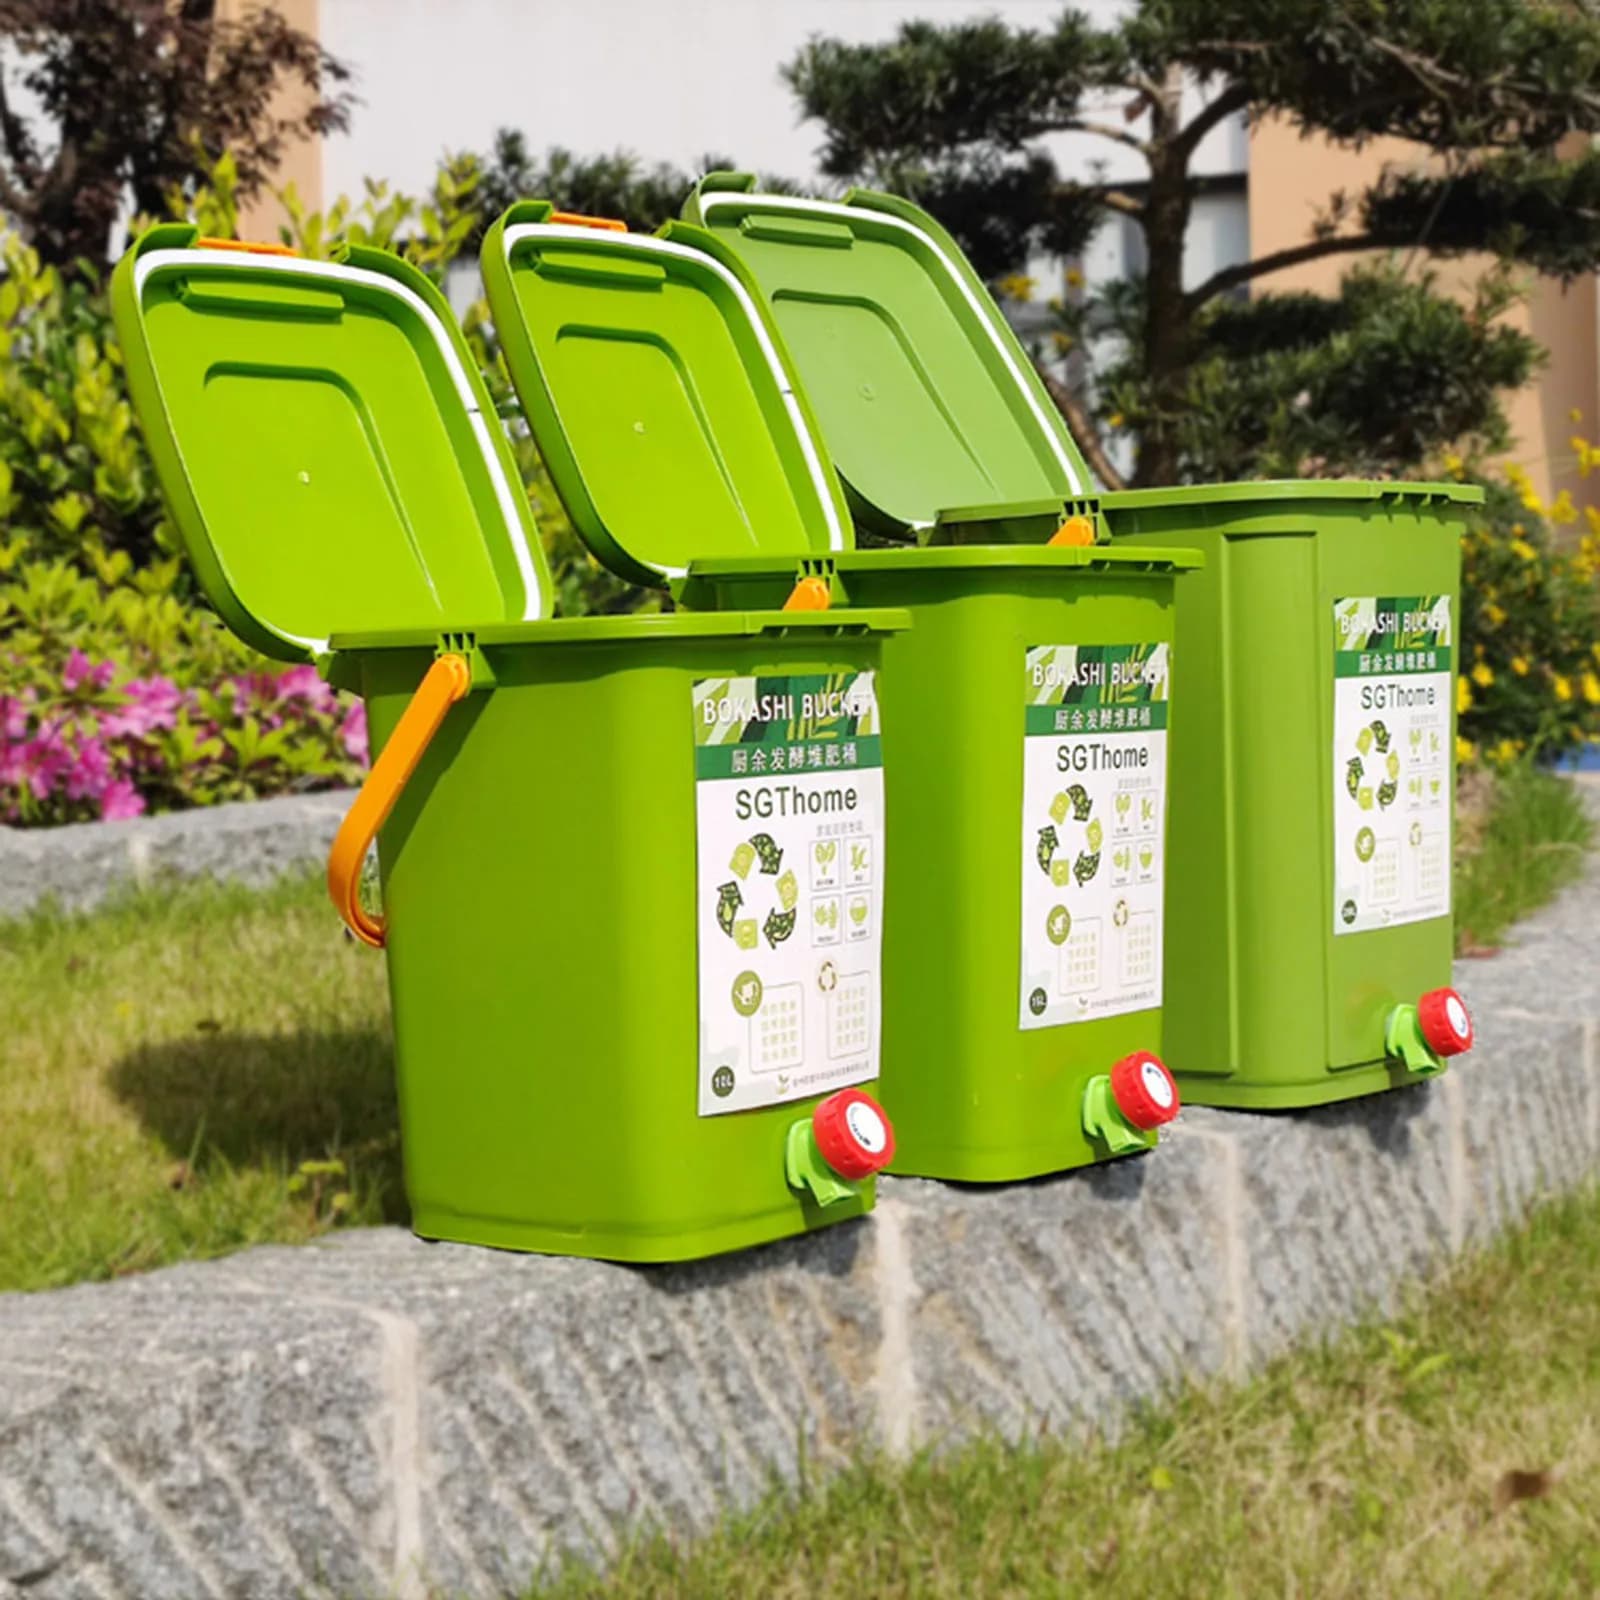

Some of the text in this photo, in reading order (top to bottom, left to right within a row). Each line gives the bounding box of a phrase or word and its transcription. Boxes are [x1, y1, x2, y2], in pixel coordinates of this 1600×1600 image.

[1033, 661, 1106, 687] BOKASHI
[703, 694, 794, 725] BOKASHI
[1361, 684, 1435, 710] SGThome
[1057, 743, 1149, 772] SGThome
[735, 786, 857, 820] SGThome
